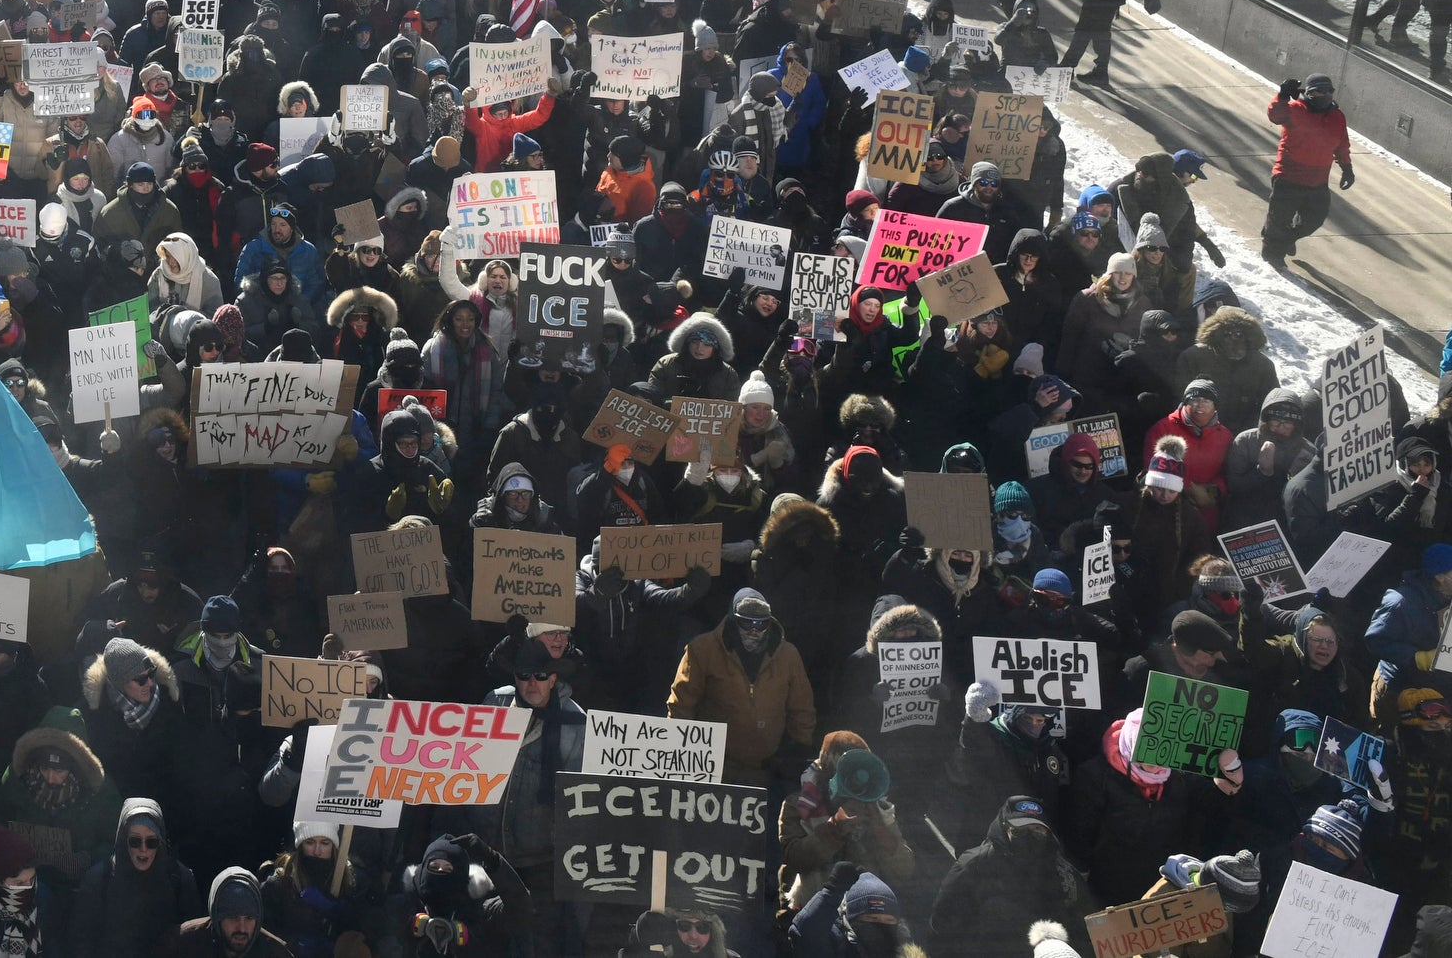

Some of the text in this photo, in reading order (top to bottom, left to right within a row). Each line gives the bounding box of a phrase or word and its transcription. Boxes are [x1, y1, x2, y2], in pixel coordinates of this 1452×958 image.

[187, 0, 214, 12] ICE
[185, 13, 214, 25] OUT
[956, 27, 968, 35] ICE
[611, 54, 642, 66] Rights
[880, 95, 928, 119] ICE
[995, 95, 1026, 112] STOP
[877, 121, 926, 148] OUT
[716, 221, 779, 243] REAL EYES
[726, 240, 770, 255] REALIZE
[521, 254, 605, 285] FUCK
[796, 254, 849, 277] ICE IS
[529, 296, 588, 327] ICE
[87, 326, 116, 342] OUR
[74, 343, 131, 366] MN NICE
[77, 367, 134, 387] ENDS WITH
[96, 387, 116, 401] ICE
[1328, 382, 1388, 428] GOOD
[687, 419, 722, 435] ICE
[1328, 443, 1395, 494] FASCISTS
[880, 647, 940, 662] ICE OUT
[991, 640, 1089, 673] Abolish
[268, 660, 365, 696] No ICE
[1001, 670, 1086, 707] ICE
[1173, 678, 1218, 710] NO
[268, 695, 296, 718] No
[884, 701, 937, 721] ICE OUT
[591, 716, 712, 746] Why Are YOU
[601, 748, 715, 774] NOT SPEAKING
[563, 844, 765, 894] GET OUT
